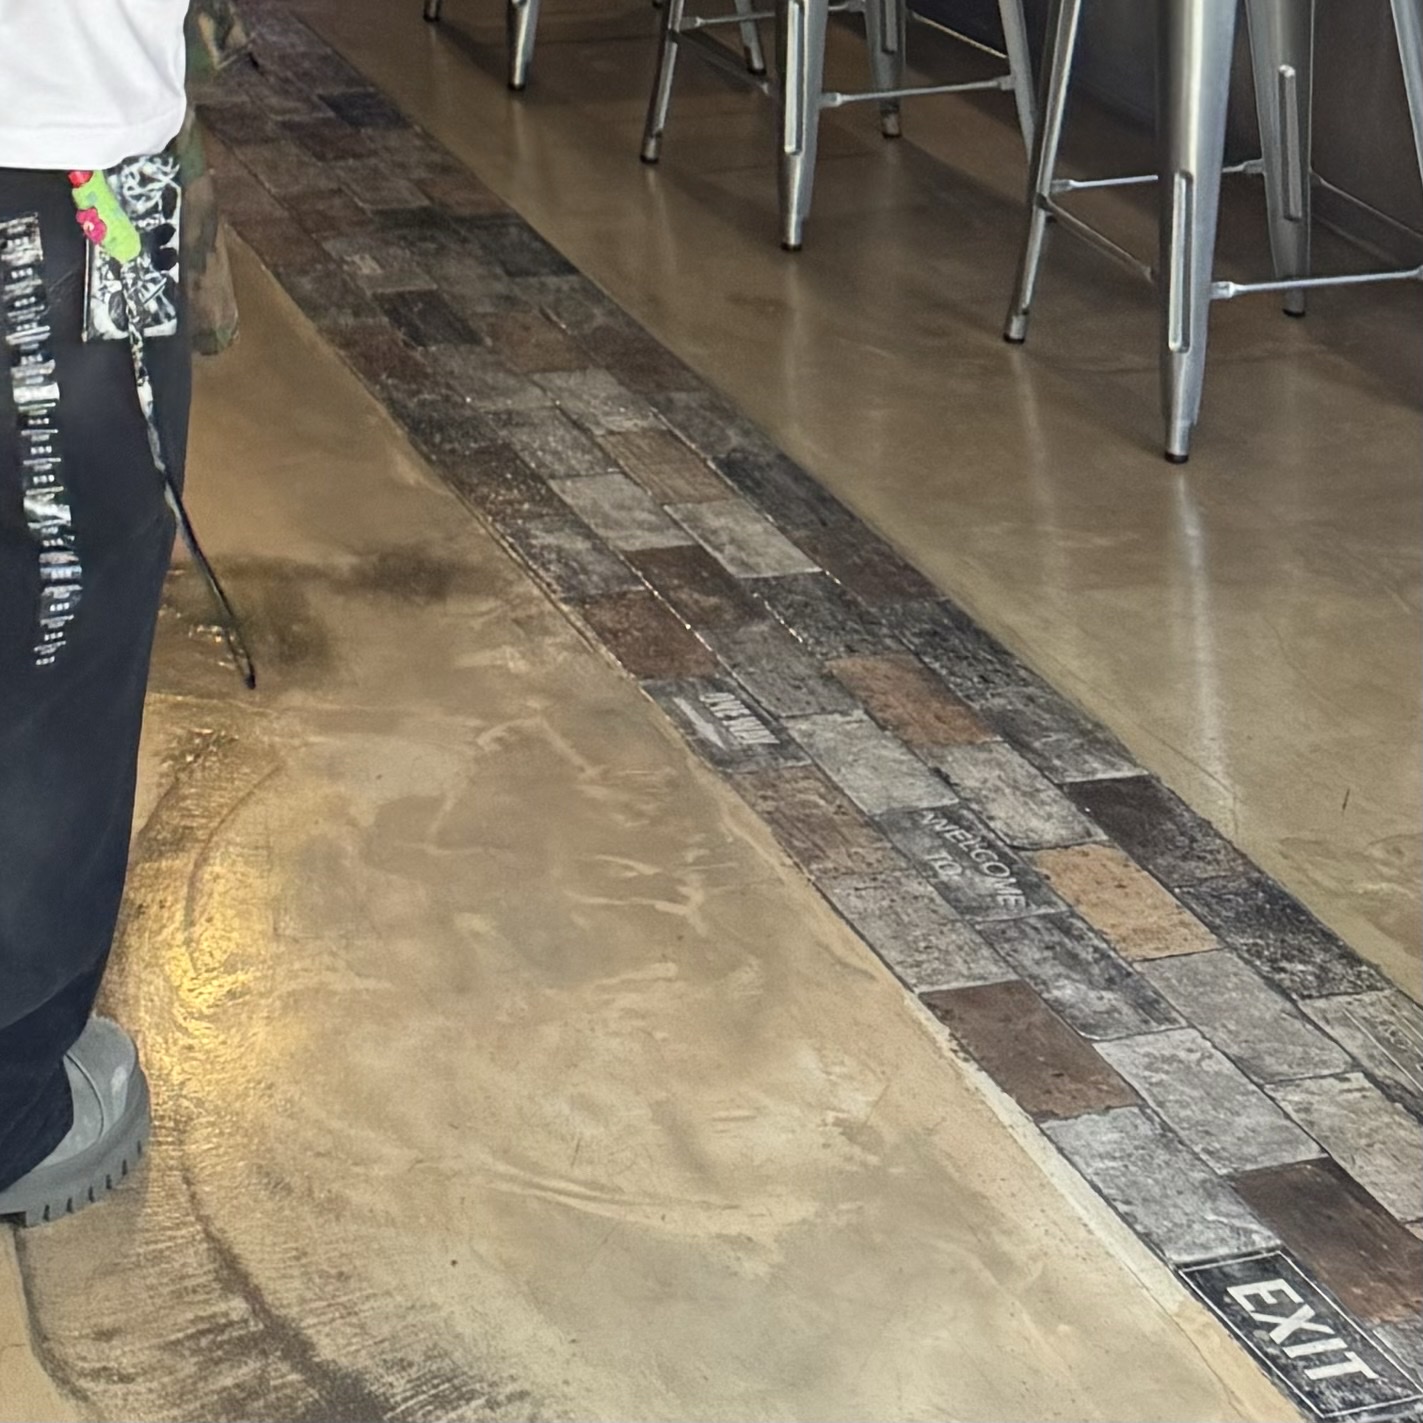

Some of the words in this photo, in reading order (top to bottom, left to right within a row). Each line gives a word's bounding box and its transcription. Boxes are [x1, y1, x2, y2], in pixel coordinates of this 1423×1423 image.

[921, 810, 1026, 911] WELCOME
[923, 851, 963, 878] TO
[1226, 1278, 1382, 1380] EXIT
